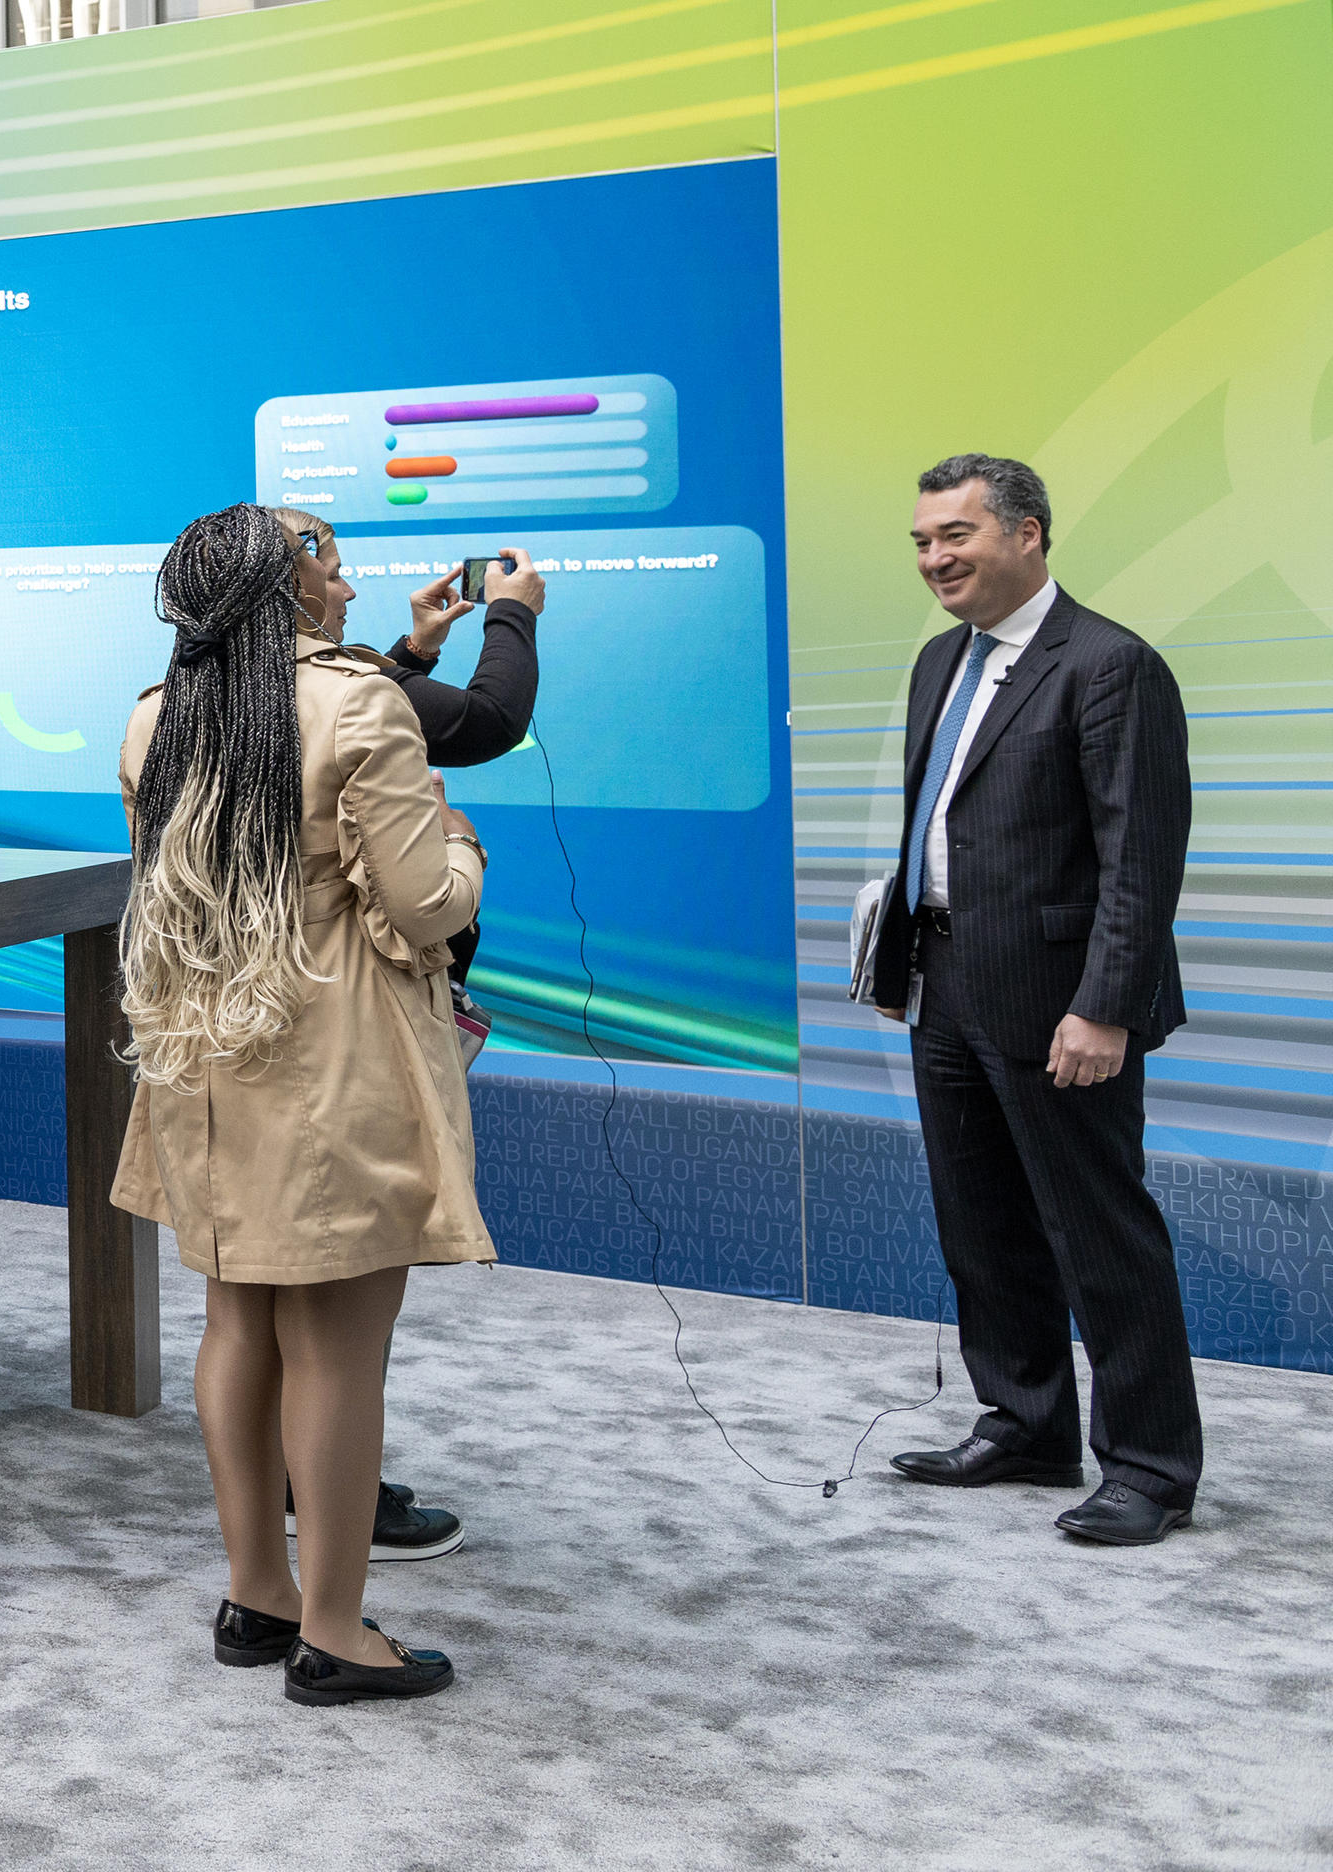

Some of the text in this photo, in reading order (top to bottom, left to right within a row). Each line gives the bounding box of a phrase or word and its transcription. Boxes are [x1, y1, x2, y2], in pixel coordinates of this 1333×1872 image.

[281, 413, 350, 428] Education
[281, 440, 324, 453] Health
[282, 465, 358, 481] Agriculture
[282, 492, 334, 505] Climate
[66, 564, 81, 575] to
[84, 562, 114, 576] help
[355, 564, 386, 579] you
[389, 561, 430, 576] think
[433, 561, 448, 575] is
[564, 558, 582, 572] to
[585, 557, 634, 572] move
[637, 553, 719, 570] forward?
[533, 1096, 678, 1129] MARSHALL
[565, 1120, 673, 1155] TUVALU
[671, 1158, 708, 1182] OF
[518, 1191, 606, 1223] BELIZE
[616, 1202, 699, 1234] BENIN
[696, 1187, 802, 1221] PANAM
[813, 1203, 910, 1237] PAPUA
[590, 1226, 705, 1261] JORDAN
